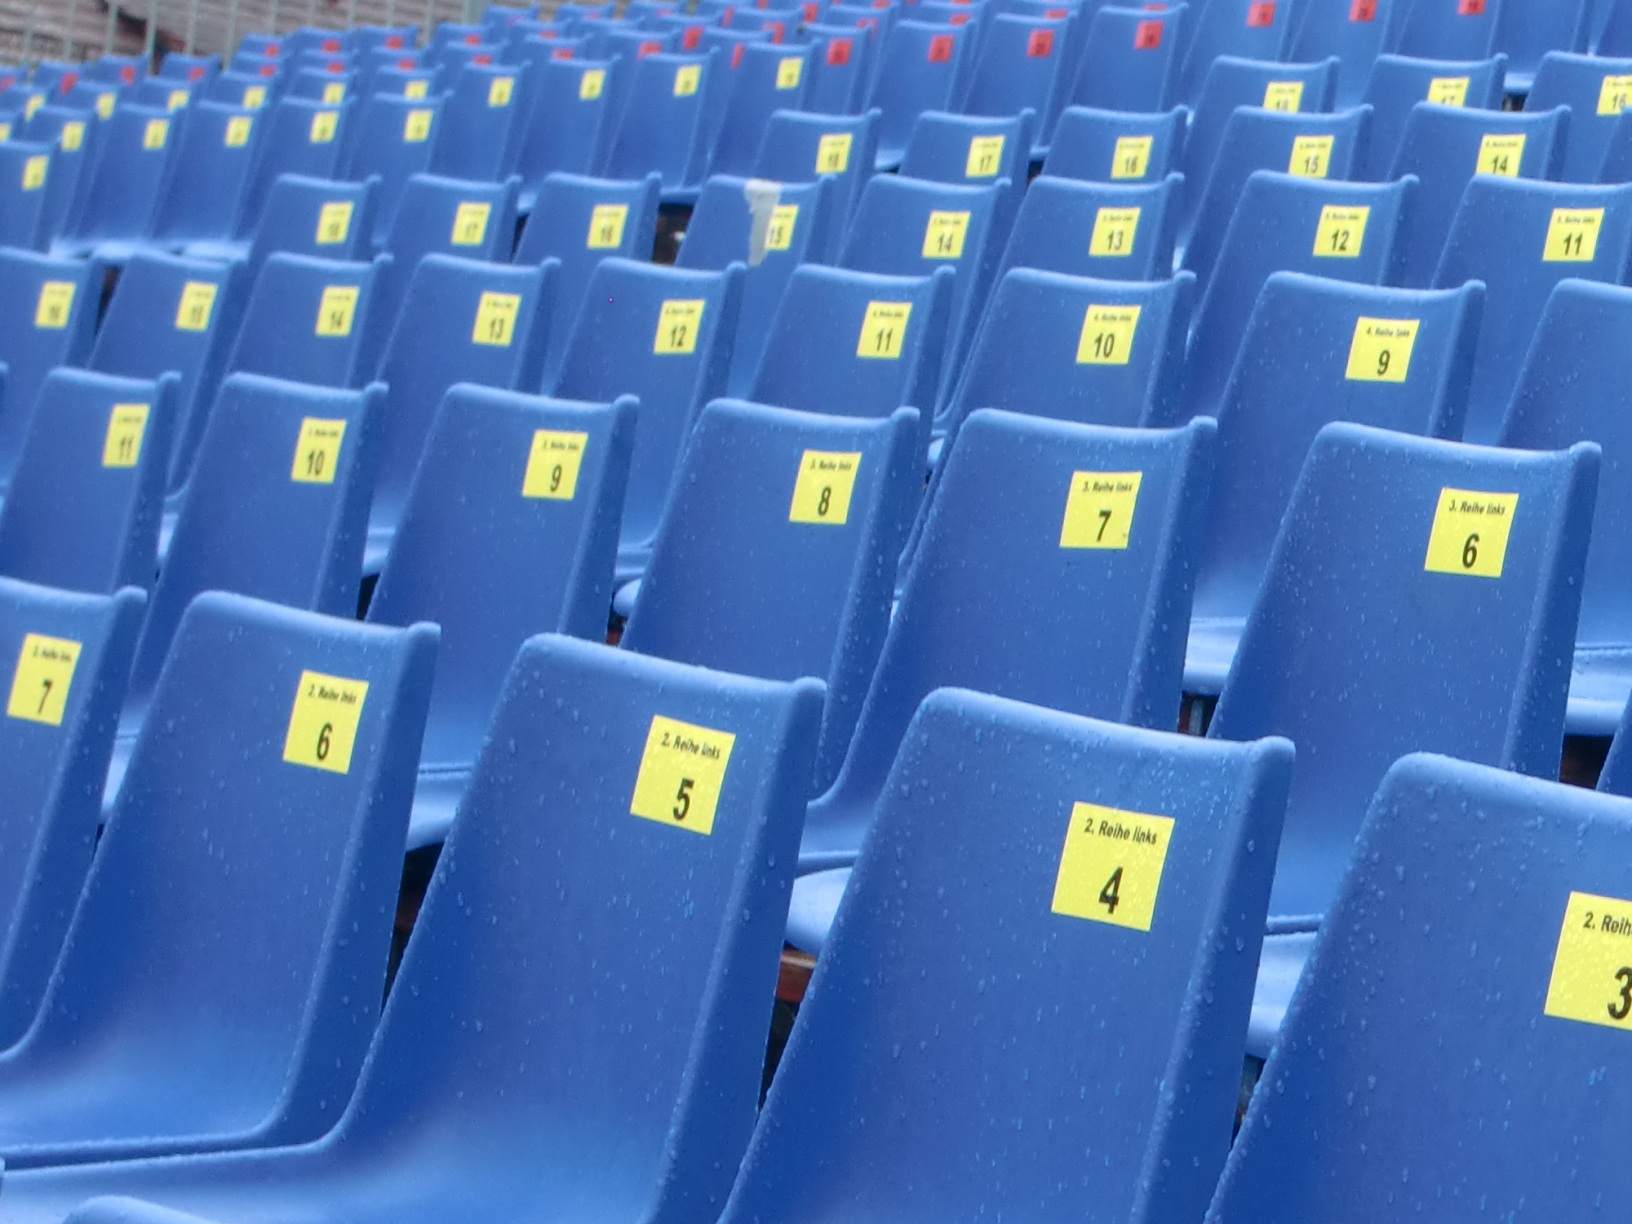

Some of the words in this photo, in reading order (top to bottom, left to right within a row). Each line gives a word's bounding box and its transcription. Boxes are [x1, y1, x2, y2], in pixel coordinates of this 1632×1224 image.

[1492, 155, 1508, 174] 14
[1107, 230, 1124, 251] 13
[1331, 229, 1350, 252] 12
[1563, 233, 1583, 256] 11
[670, 324, 687, 348] 12
[876, 328, 893, 352] 11
[1094, 332, 1115, 359] 10
[1376, 349, 1391, 376] 9
[307, 449, 325, 476] 10
[549, 463, 563, 493] 9
[1091, 481, 1115, 493] Reihe
[817, 485, 832, 517] 8
[1448, 499, 1457, 512] 3.
[1459, 500, 1485, 515] Reihe
[1486, 503, 1506, 516] links
[1096, 509, 1113, 542] 7
[1462, 533, 1480, 569] 6
[38, 678, 54, 714] 7
[316, 722, 333, 762] 6
[660, 731, 671, 748] 2.
[672, 734, 700, 755] Reihe
[700, 742, 721, 760] links
[672, 777, 695, 821] 5
[1083, 817, 1095, 835] 2.
[1098, 819, 1131, 841] Reihe
[1132, 825, 1158, 846] links
[1098, 866, 1124, 915] 4
[1582, 911, 1596, 930] 2.
